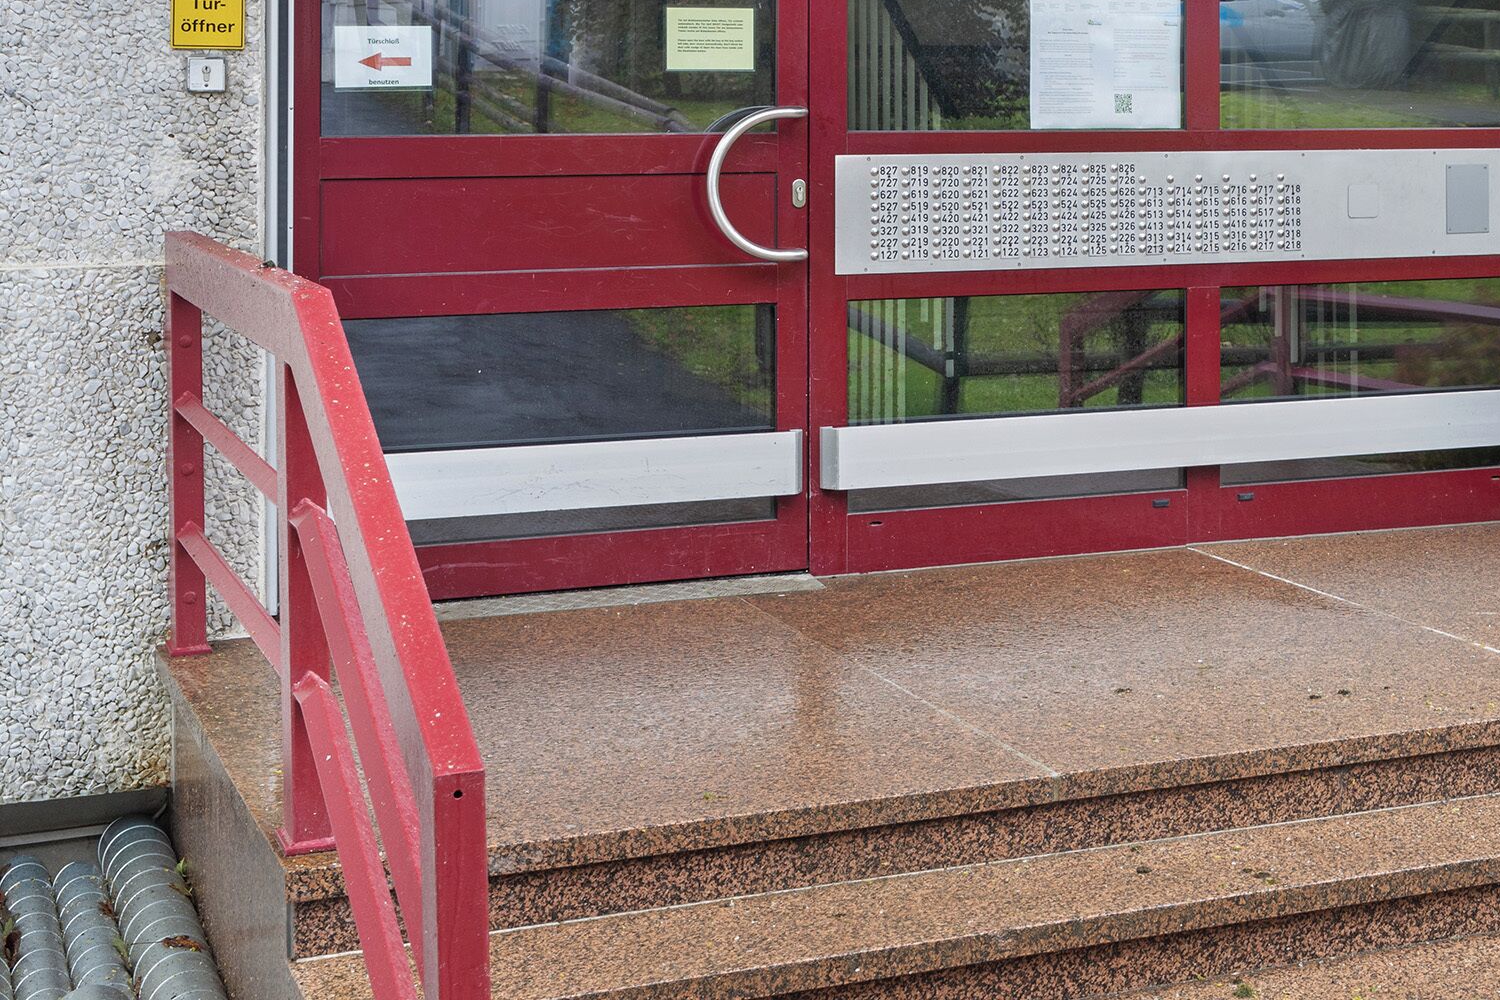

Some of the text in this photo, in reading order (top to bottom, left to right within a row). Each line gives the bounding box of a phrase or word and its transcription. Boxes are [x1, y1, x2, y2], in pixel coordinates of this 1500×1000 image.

[181, 18, 236, 33] öffner
[367, 37, 400, 45] Türschloß
[880, 164, 1136, 175] 827 819 820 821 822 823 824 825 826
[880, 176, 1136, 187] 727 719 720 721 722 723 724 725 726
[880, 185, 1301, 199] 627 619 620 621 622 623 624 625 626 713 714 715 716 717 718
[880, 196, 1301, 211] 527 519 520 521 522 523 524 525 526 613 614 615 616 617 618
[880, 207, 1301, 223] 427 419 420 421 422 423 424 425 426 513 514 515 516 517 518
[880, 218, 1301, 235] 327 319 320 321 322 323 324 325 326 413 414 415 416 417 418
[880, 230, 1301, 247] 227 219 220 221 222 223 224 225 226 313 314 315 316 317 318
[880, 241, 1301, 260] 127 119 120 121 122 123 124 125 126 213 214 215 216 217 218
